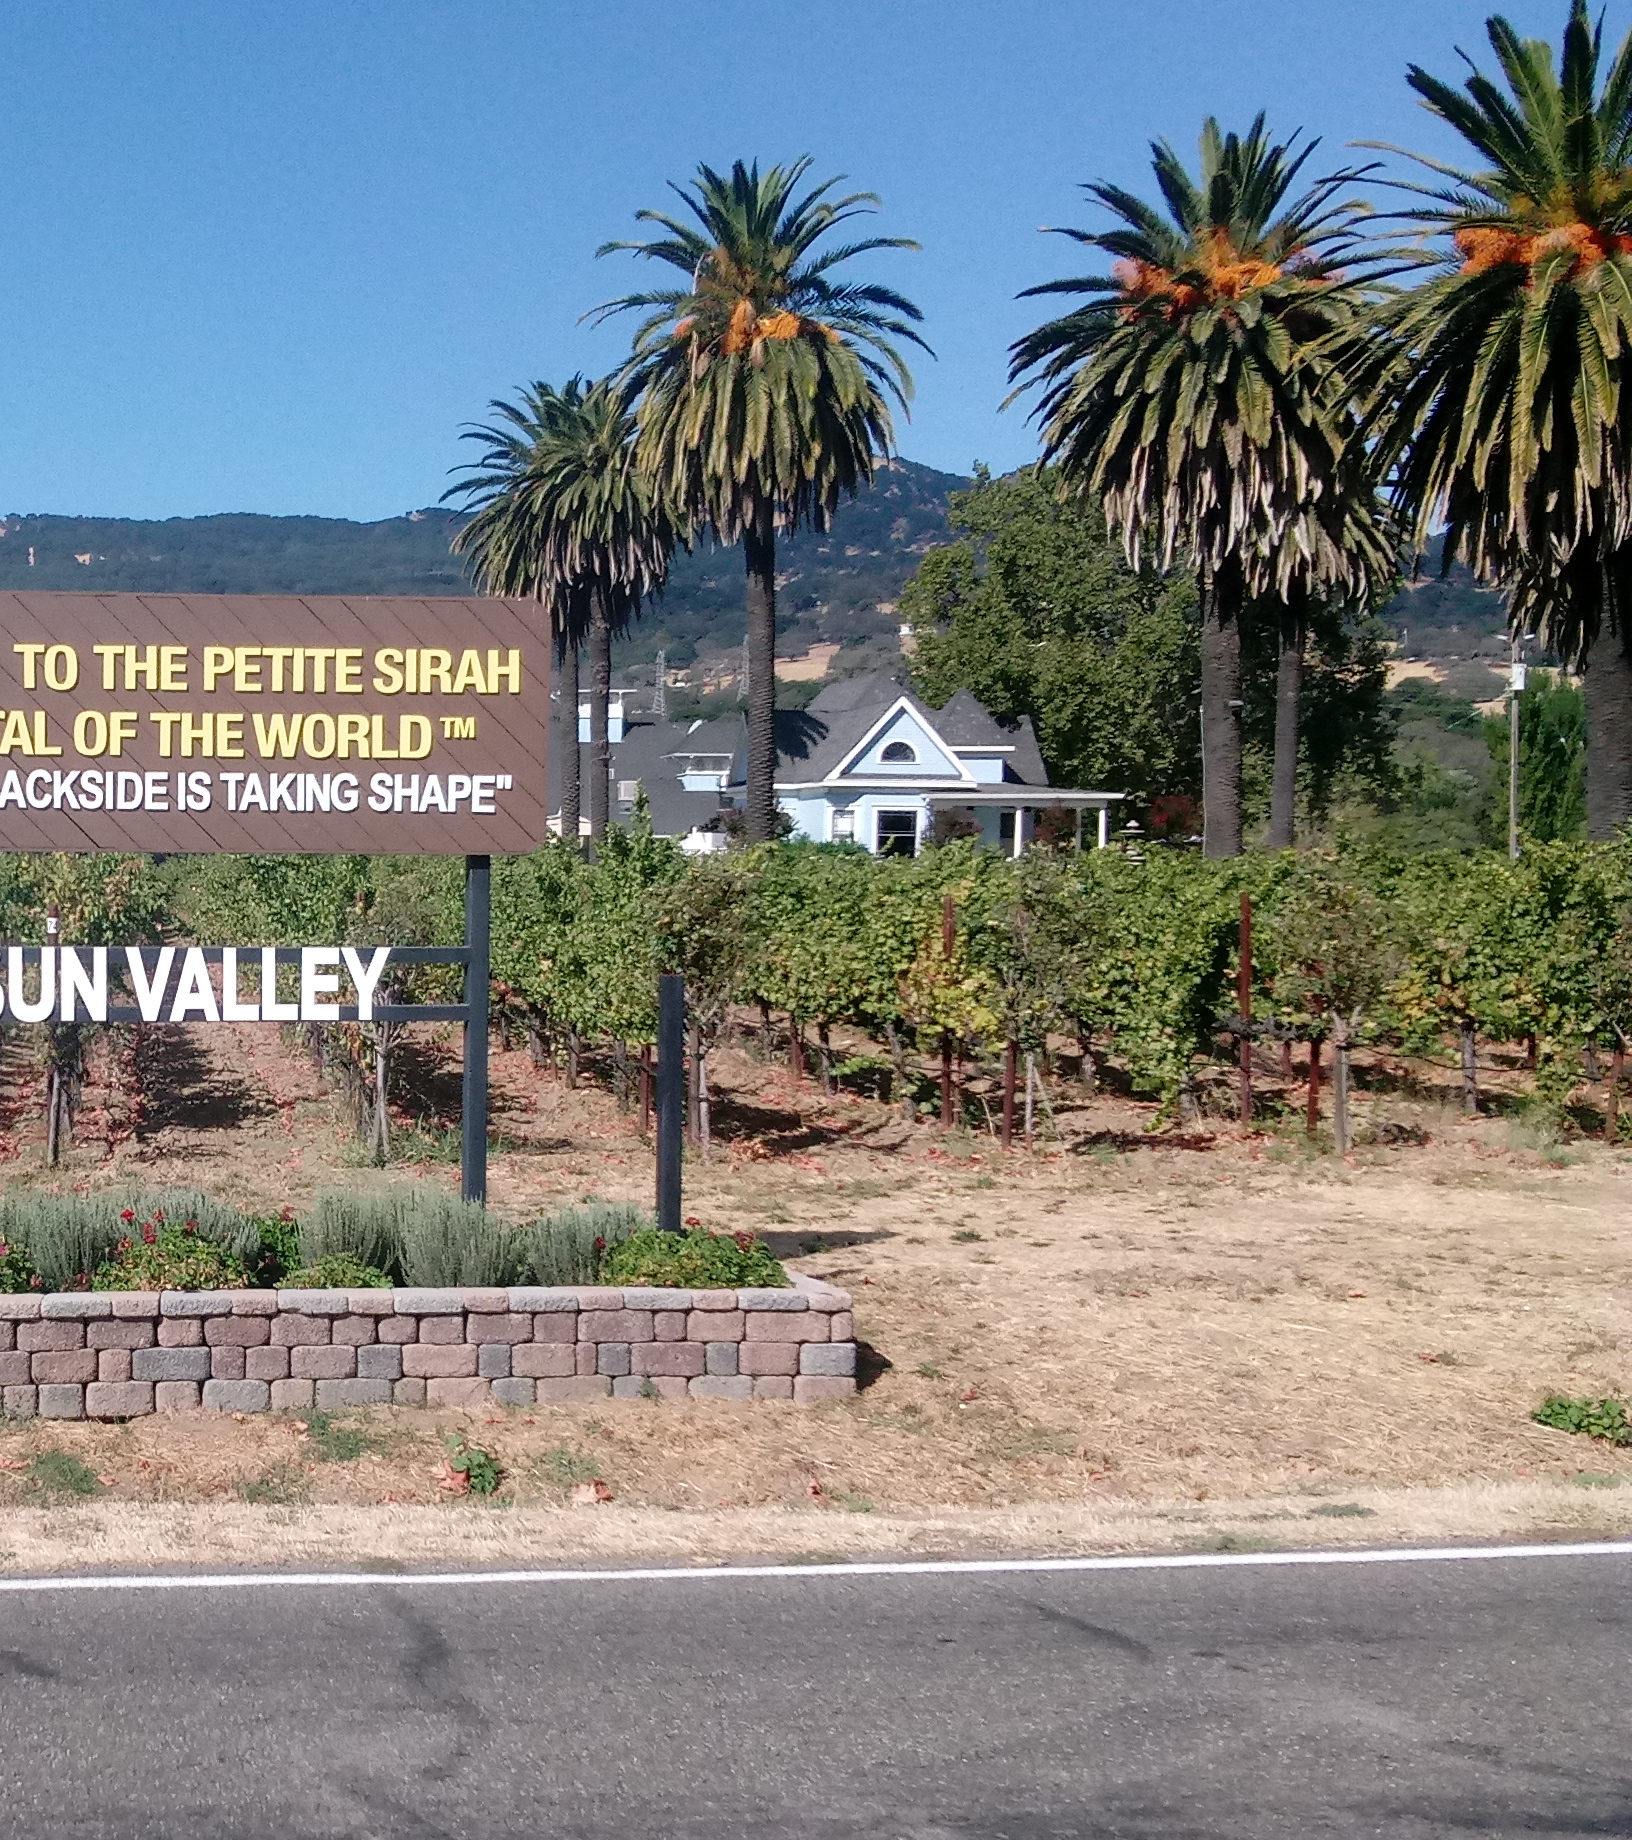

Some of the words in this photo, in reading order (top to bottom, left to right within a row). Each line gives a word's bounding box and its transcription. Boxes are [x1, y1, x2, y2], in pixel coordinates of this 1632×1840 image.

[13, 643, 79, 692] TO
[93, 645, 188, 691] THE
[203, 646, 363, 693] PETITE
[373, 648, 521, 694] SIRAH
[73, 710, 137, 756] OF
[150, 712, 244, 758] THE
[252, 713, 432, 759] WORLD
[177, 771, 211, 811] IS
[219, 772, 359, 813] TAKING
[368, 773, 512, 814] SHAPE"
[125, 946, 393, 1022] VALLEY
